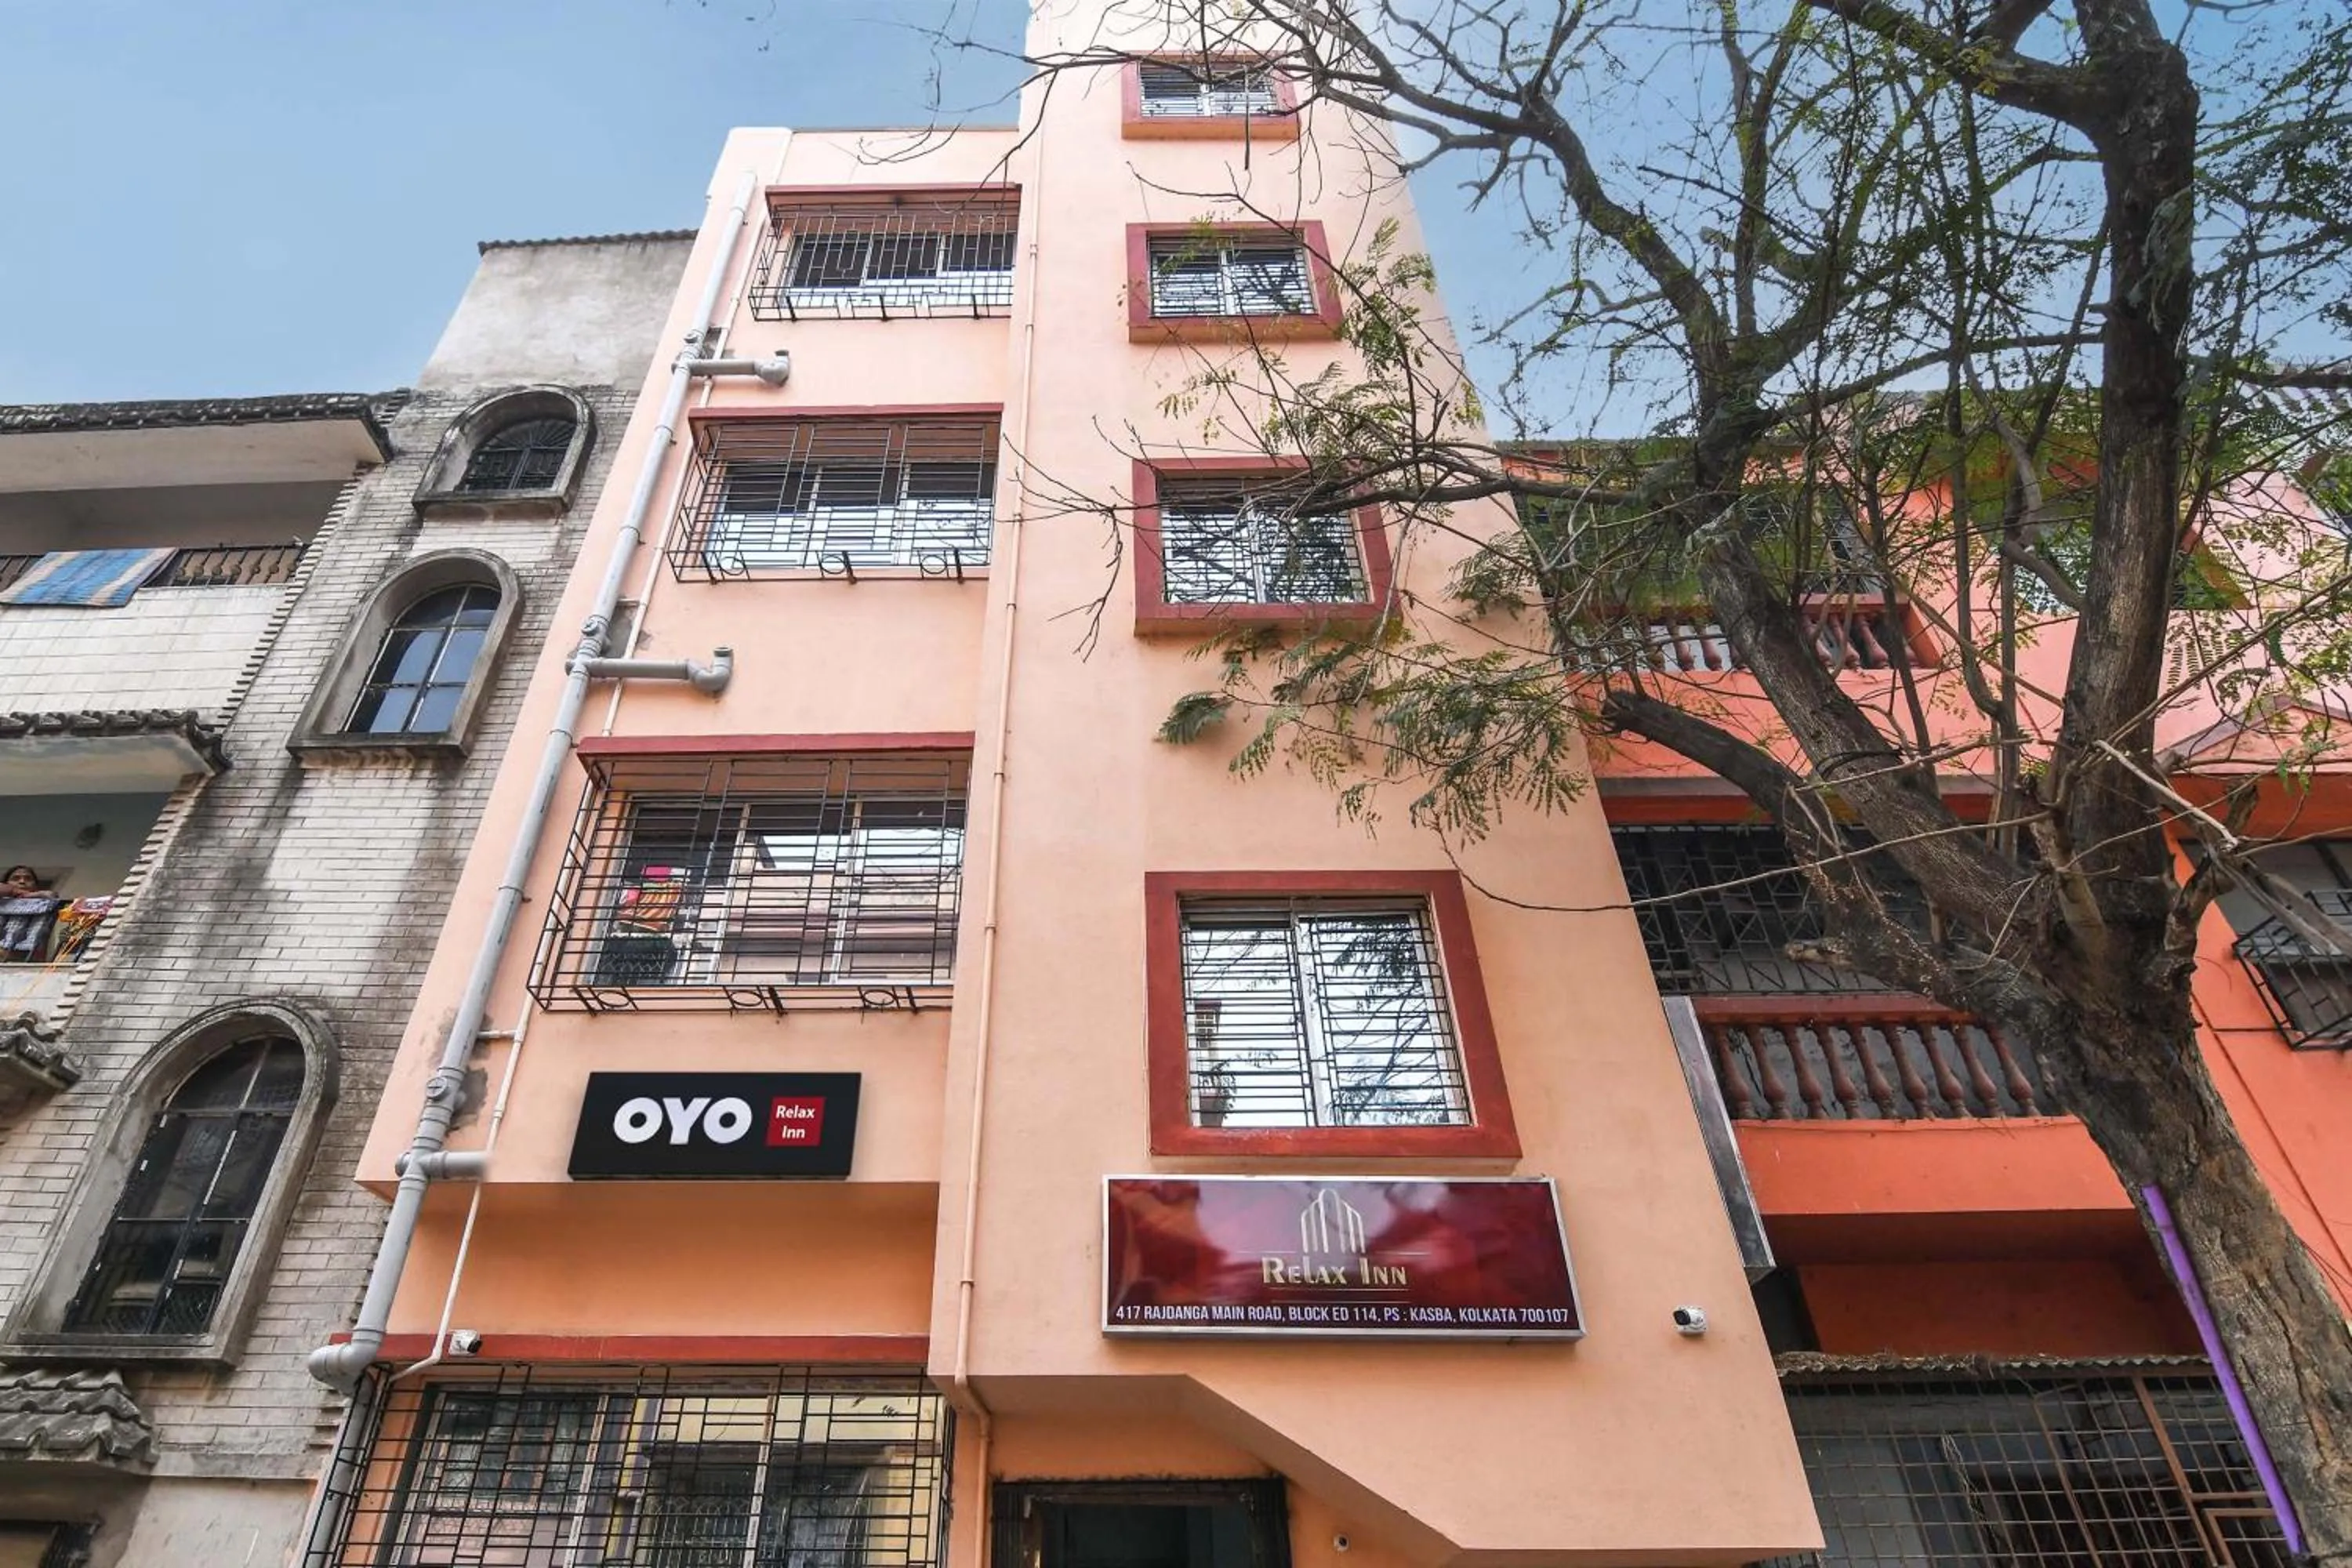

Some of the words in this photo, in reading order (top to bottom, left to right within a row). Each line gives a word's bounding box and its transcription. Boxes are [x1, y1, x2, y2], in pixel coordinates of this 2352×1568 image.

[775, 1105, 815, 1120] Relax
[613, 1097, 753, 1145] OYO
[782, 1125, 806, 1139] Inn
[1116, 1305, 1141, 1320] 417
[1144, 1305, 1210, 1320] RAJDANGA
[1212, 1305, 1244, 1320] MAIN
[1247, 1305, 1286, 1323] ROAD,
[1288, 1306, 1330, 1321] BLOCK
[1333, 1307, 1349, 1321] ED
[1459, 1308, 1517, 1323] KOLKATA
[1519, 1308, 1569, 1323] 700107
